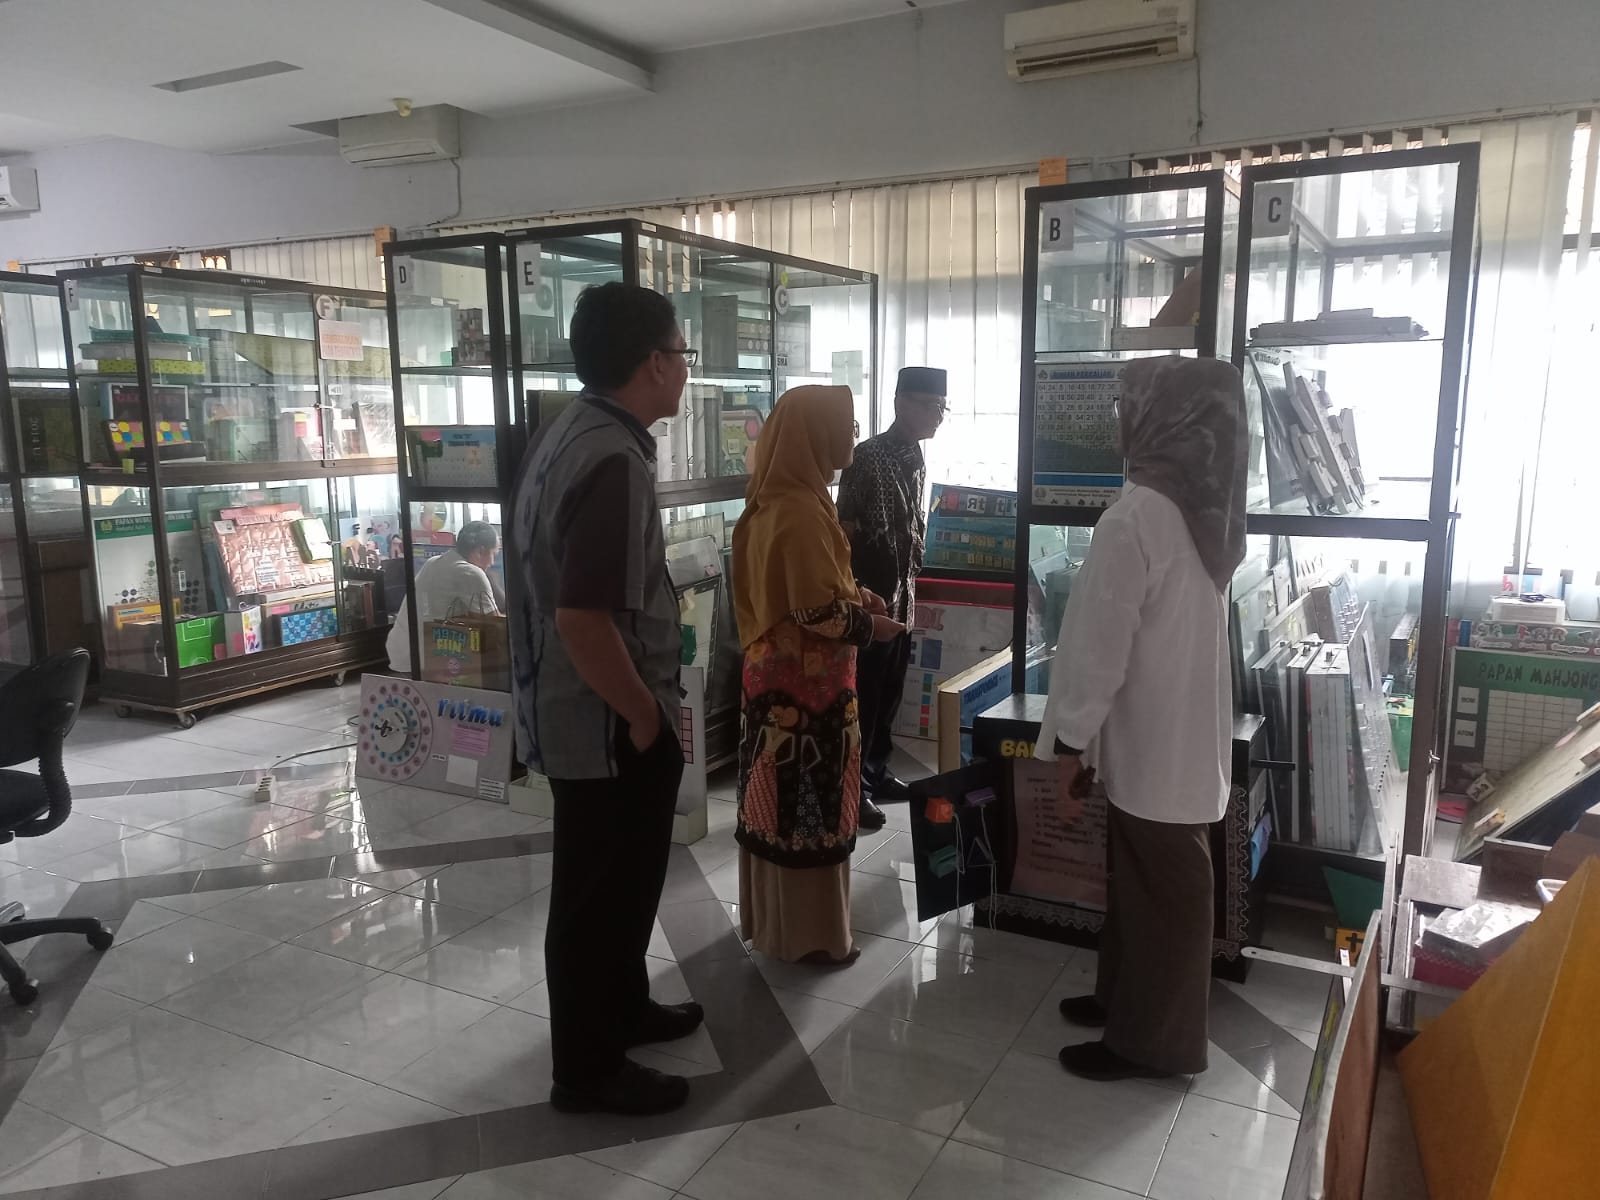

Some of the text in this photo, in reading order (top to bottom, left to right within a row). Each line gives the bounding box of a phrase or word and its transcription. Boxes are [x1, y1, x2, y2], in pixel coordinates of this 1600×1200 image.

[1267, 196, 1282, 224] C
[1049, 217, 1061, 242] B
[399, 265, 407, 284] D
[523, 260, 535, 286] E
[67, 287, 75, 302] F
[319, 299, 331, 317] F
[1479, 661, 1600, 691] PAPAN MAHJONG
[1001, 739, 1036, 759] BA
